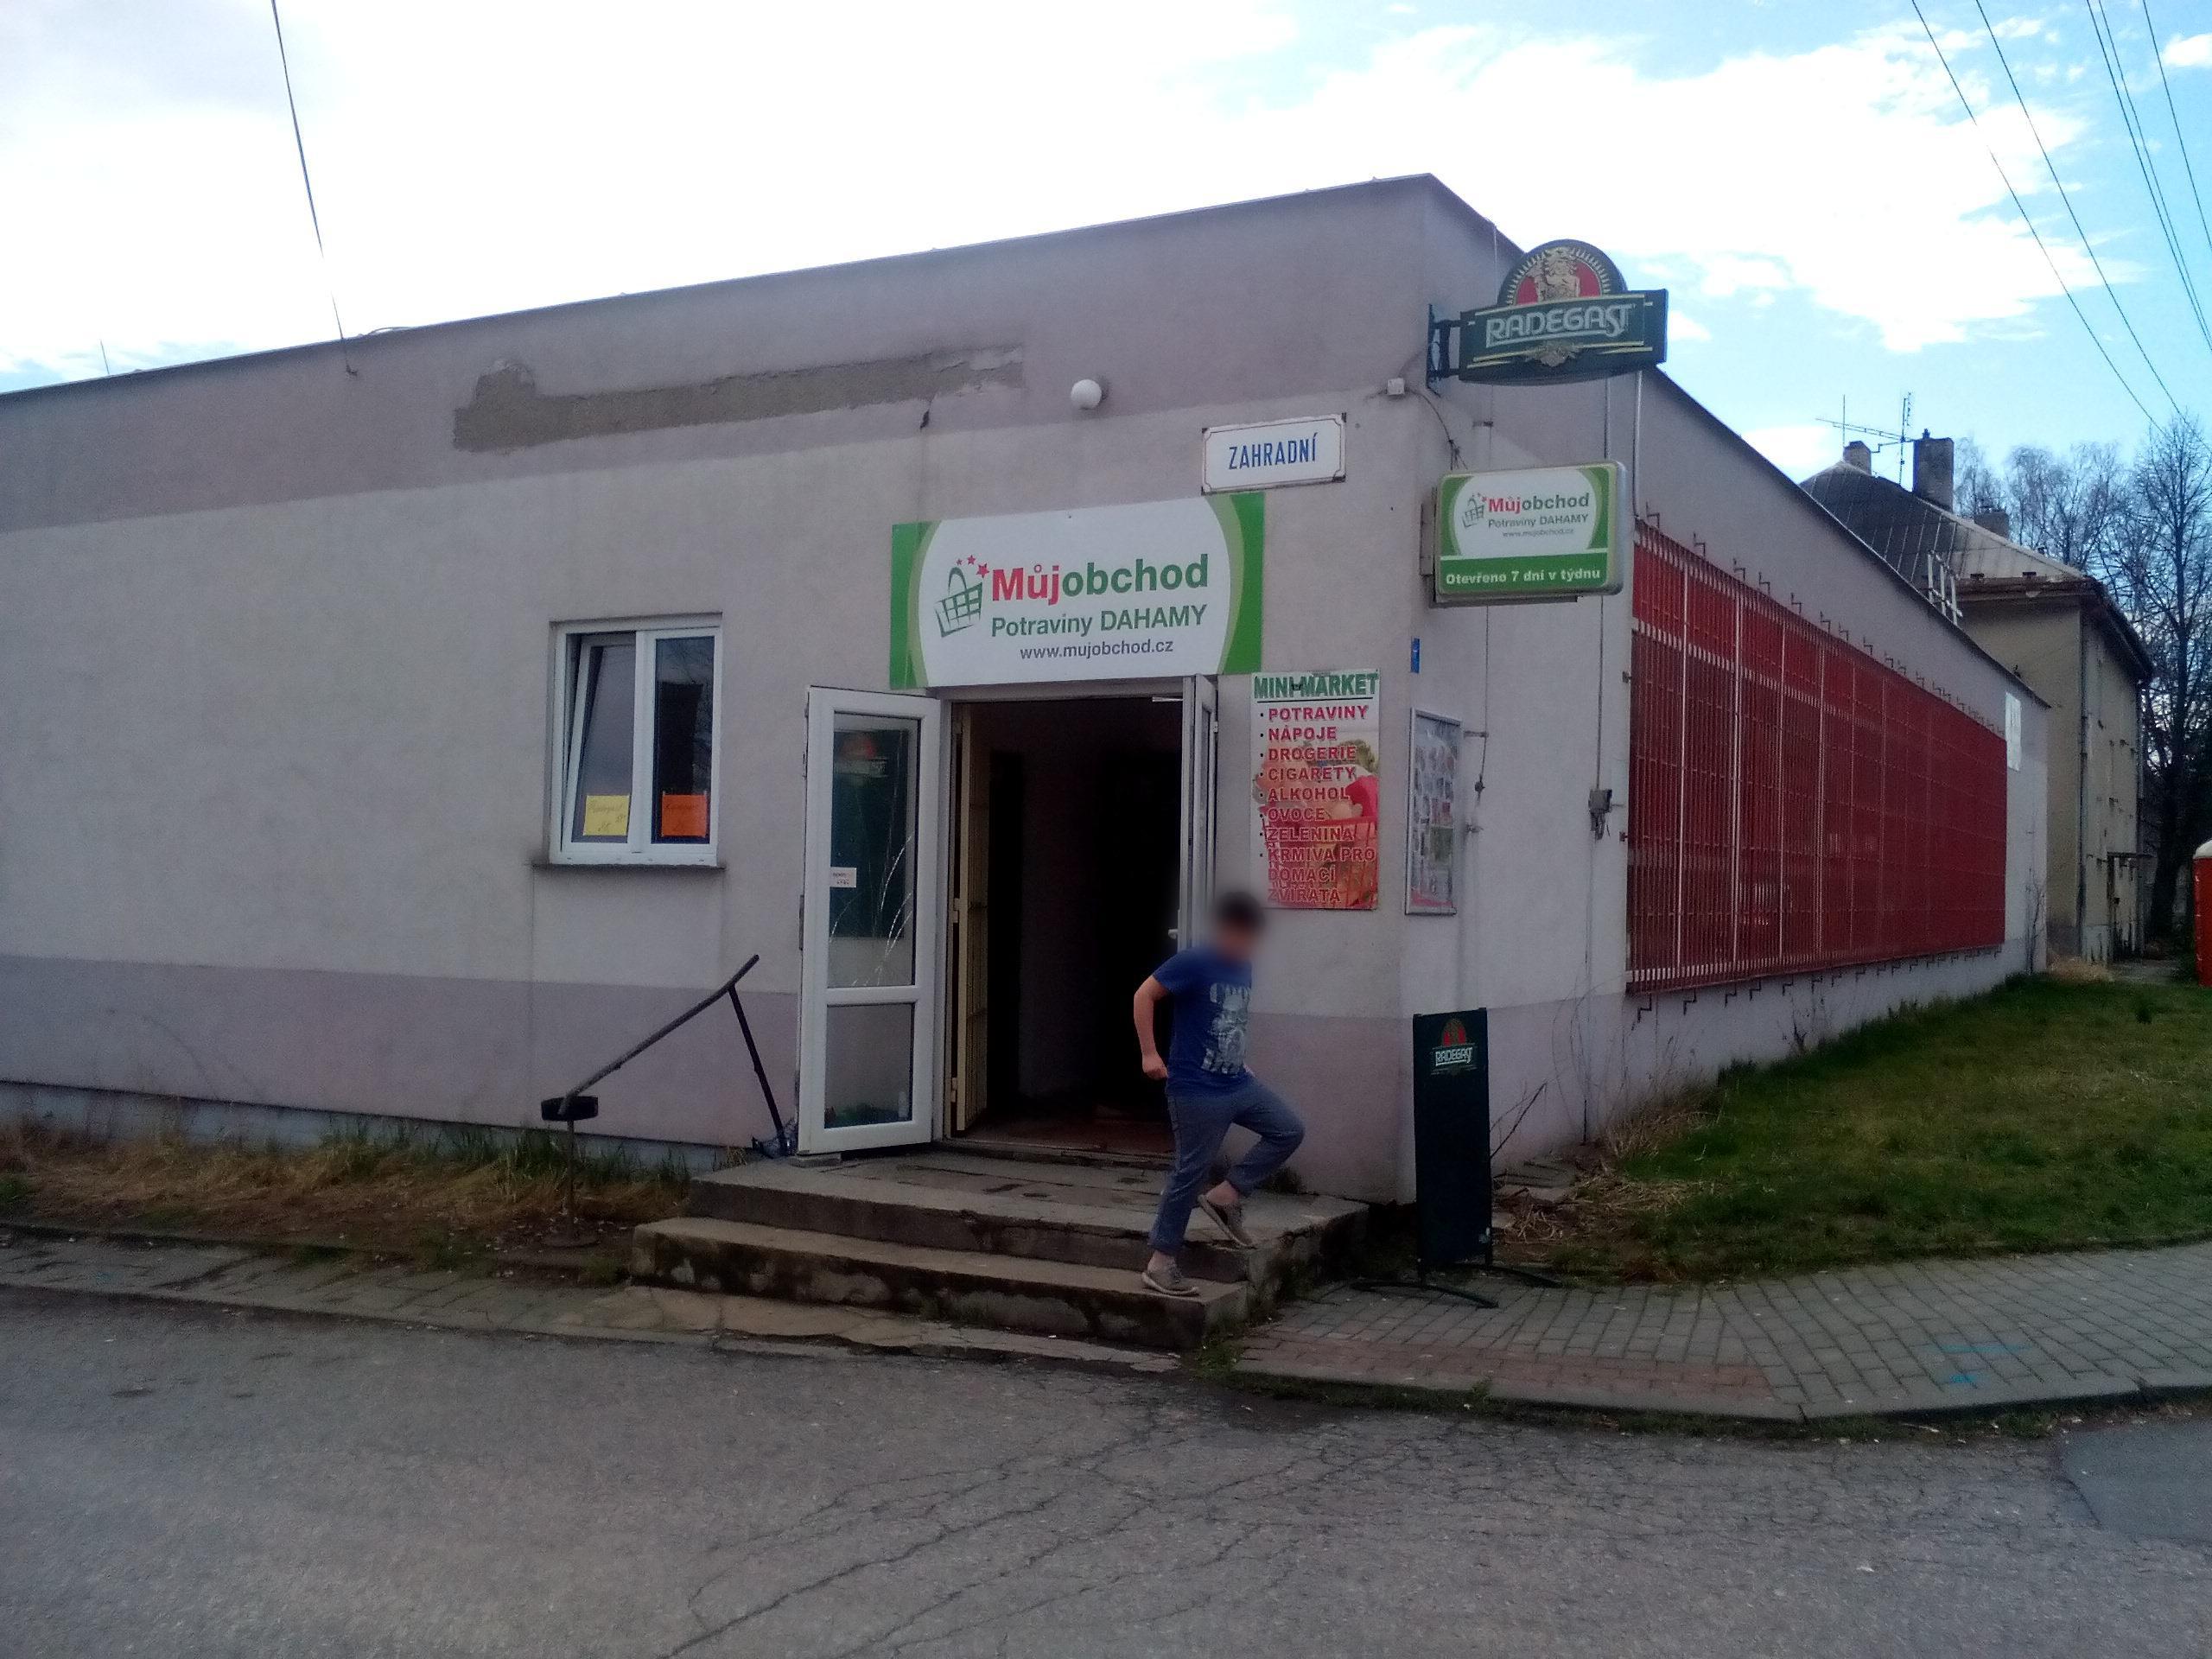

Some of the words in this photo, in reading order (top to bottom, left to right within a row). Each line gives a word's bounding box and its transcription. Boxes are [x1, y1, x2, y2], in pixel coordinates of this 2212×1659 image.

[1485, 302, 1632, 348] RADEGAST
[1228, 433, 1318, 471] ZAHRADNÍ
[1488, 518, 1536, 529] Potraviny
[1540, 514, 1589, 525] DAHAMY
[991, 554, 1209, 605] Můjobchod
[1446, 572, 1507, 585] Otevřeno
[1511, 571, 1520, 582] 7
[1523, 569, 1545, 582] dní
[1560, 567, 1601, 582] týdnu
[991, 611, 1092, 638] Potraviny
[1100, 604, 1208, 632] DAHAMY
[1020, 639, 1174, 660] www.mujobchod.cz
[1268, 705, 1369, 721] POTRAVINY
[1268, 725, 1338, 741] NÁPOJE
[1268, 746, 1357, 761] DROGERIE
[1268, 766, 1357, 782] CIGARETY
[1268, 786, 1349, 802] ALKOHOL
[1268, 807, 1326, 822] OVOCE
[1267, 827, 1356, 842] ZELENINA
[1268, 848, 1338, 862] KRMIVA
[1339, 847, 1376, 861] PRO
[1435, 1046, 1473, 1066] RADEGAST
